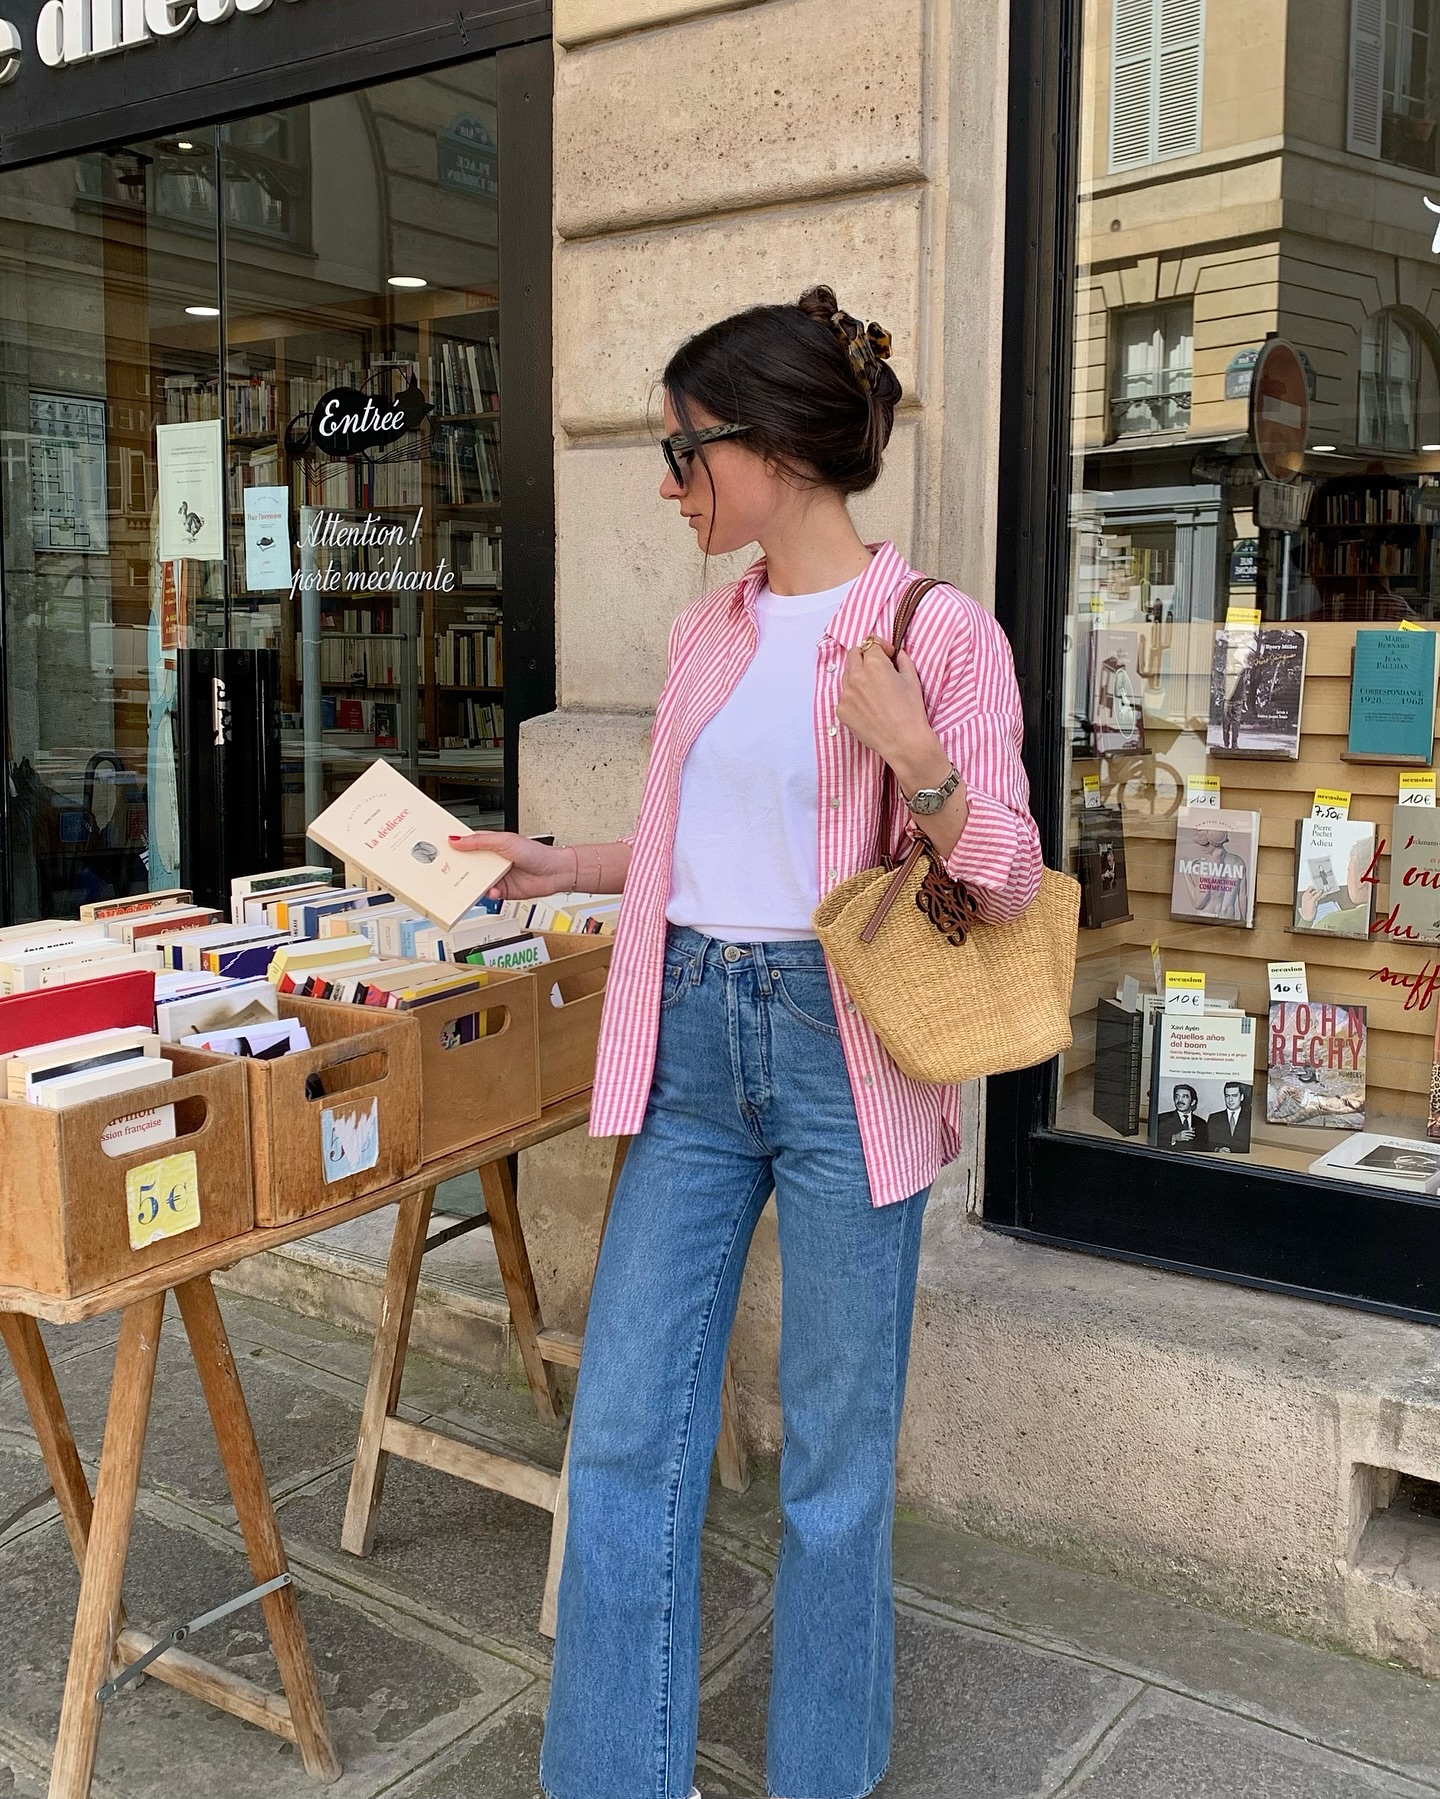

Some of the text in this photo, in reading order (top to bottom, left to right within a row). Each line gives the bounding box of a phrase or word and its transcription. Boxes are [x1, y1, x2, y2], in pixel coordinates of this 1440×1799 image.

[319, 398, 405, 437] Entrée
[289, 556, 455, 600] porte méchante
[1317, 794, 1347, 802] occasion
[364, 839, 379, 849] La
[377, 808, 410, 839] dédicace
[1312, 830, 1333, 838] Pachet
[1310, 839, 1333, 847] Adieu
[1179, 859, 1244, 879] McEWAN
[1369, 903, 1420, 940] du
[490, 959, 497, 967] LA
[497, 947, 539, 969] GRANDE
[1271, 1002, 1364, 1039] JOHN
[1170, 1031, 1225, 1041] Aquellos años
[1184, 1041, 1207, 1049] boom
[1271, 1034, 1364, 1070] RECHY
[124, 1118, 162, 1135] française
[138, 1180, 188, 1226] 5 €
